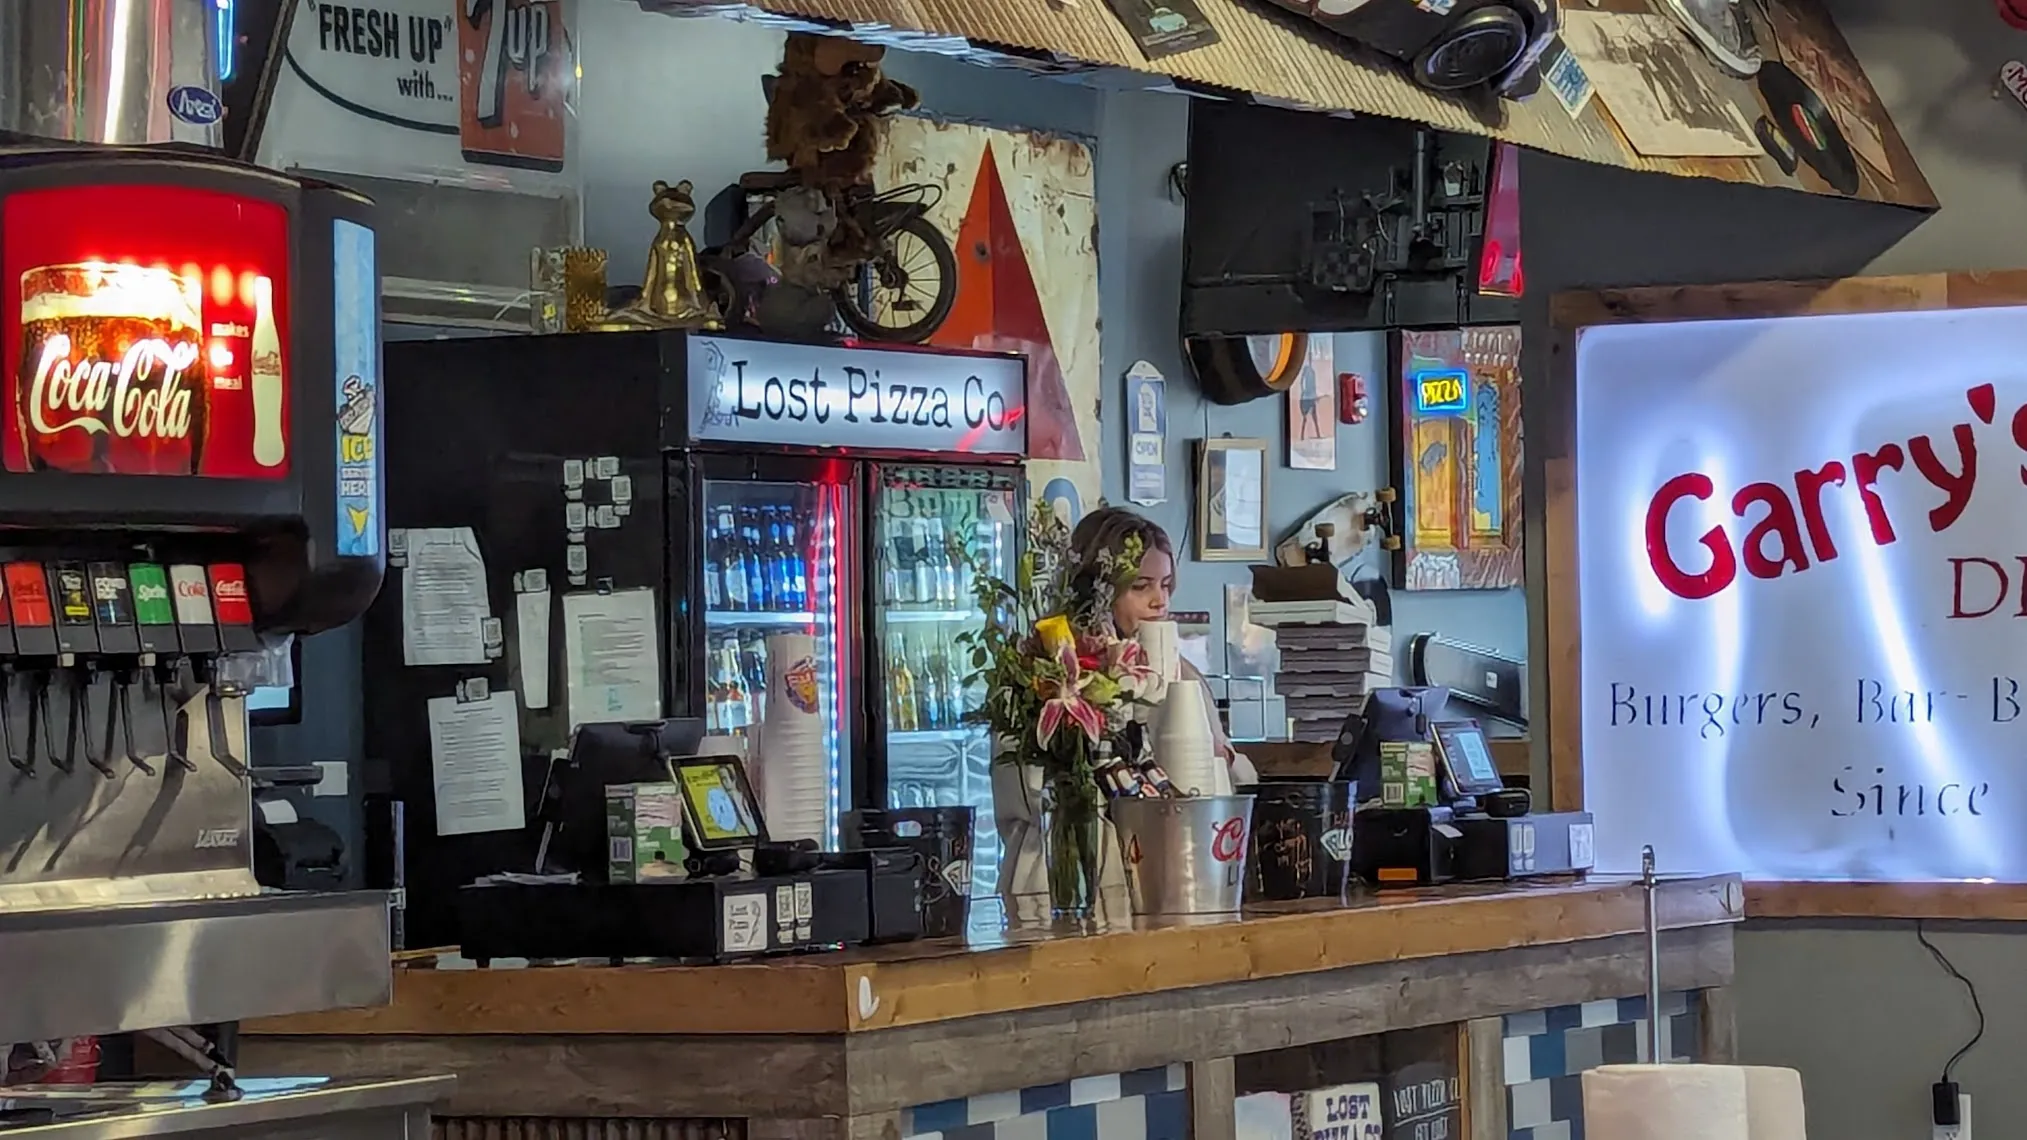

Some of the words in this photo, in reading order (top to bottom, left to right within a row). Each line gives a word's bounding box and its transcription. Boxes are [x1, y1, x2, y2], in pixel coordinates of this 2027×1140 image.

[731, 360, 829, 424] Lost
[842, 365, 952, 429] Pizza
[1609, 682, 1821, 741] Burgers,
[1830, 766, 1990, 818] Since
[1324, 1094, 1371, 1123] LOST
